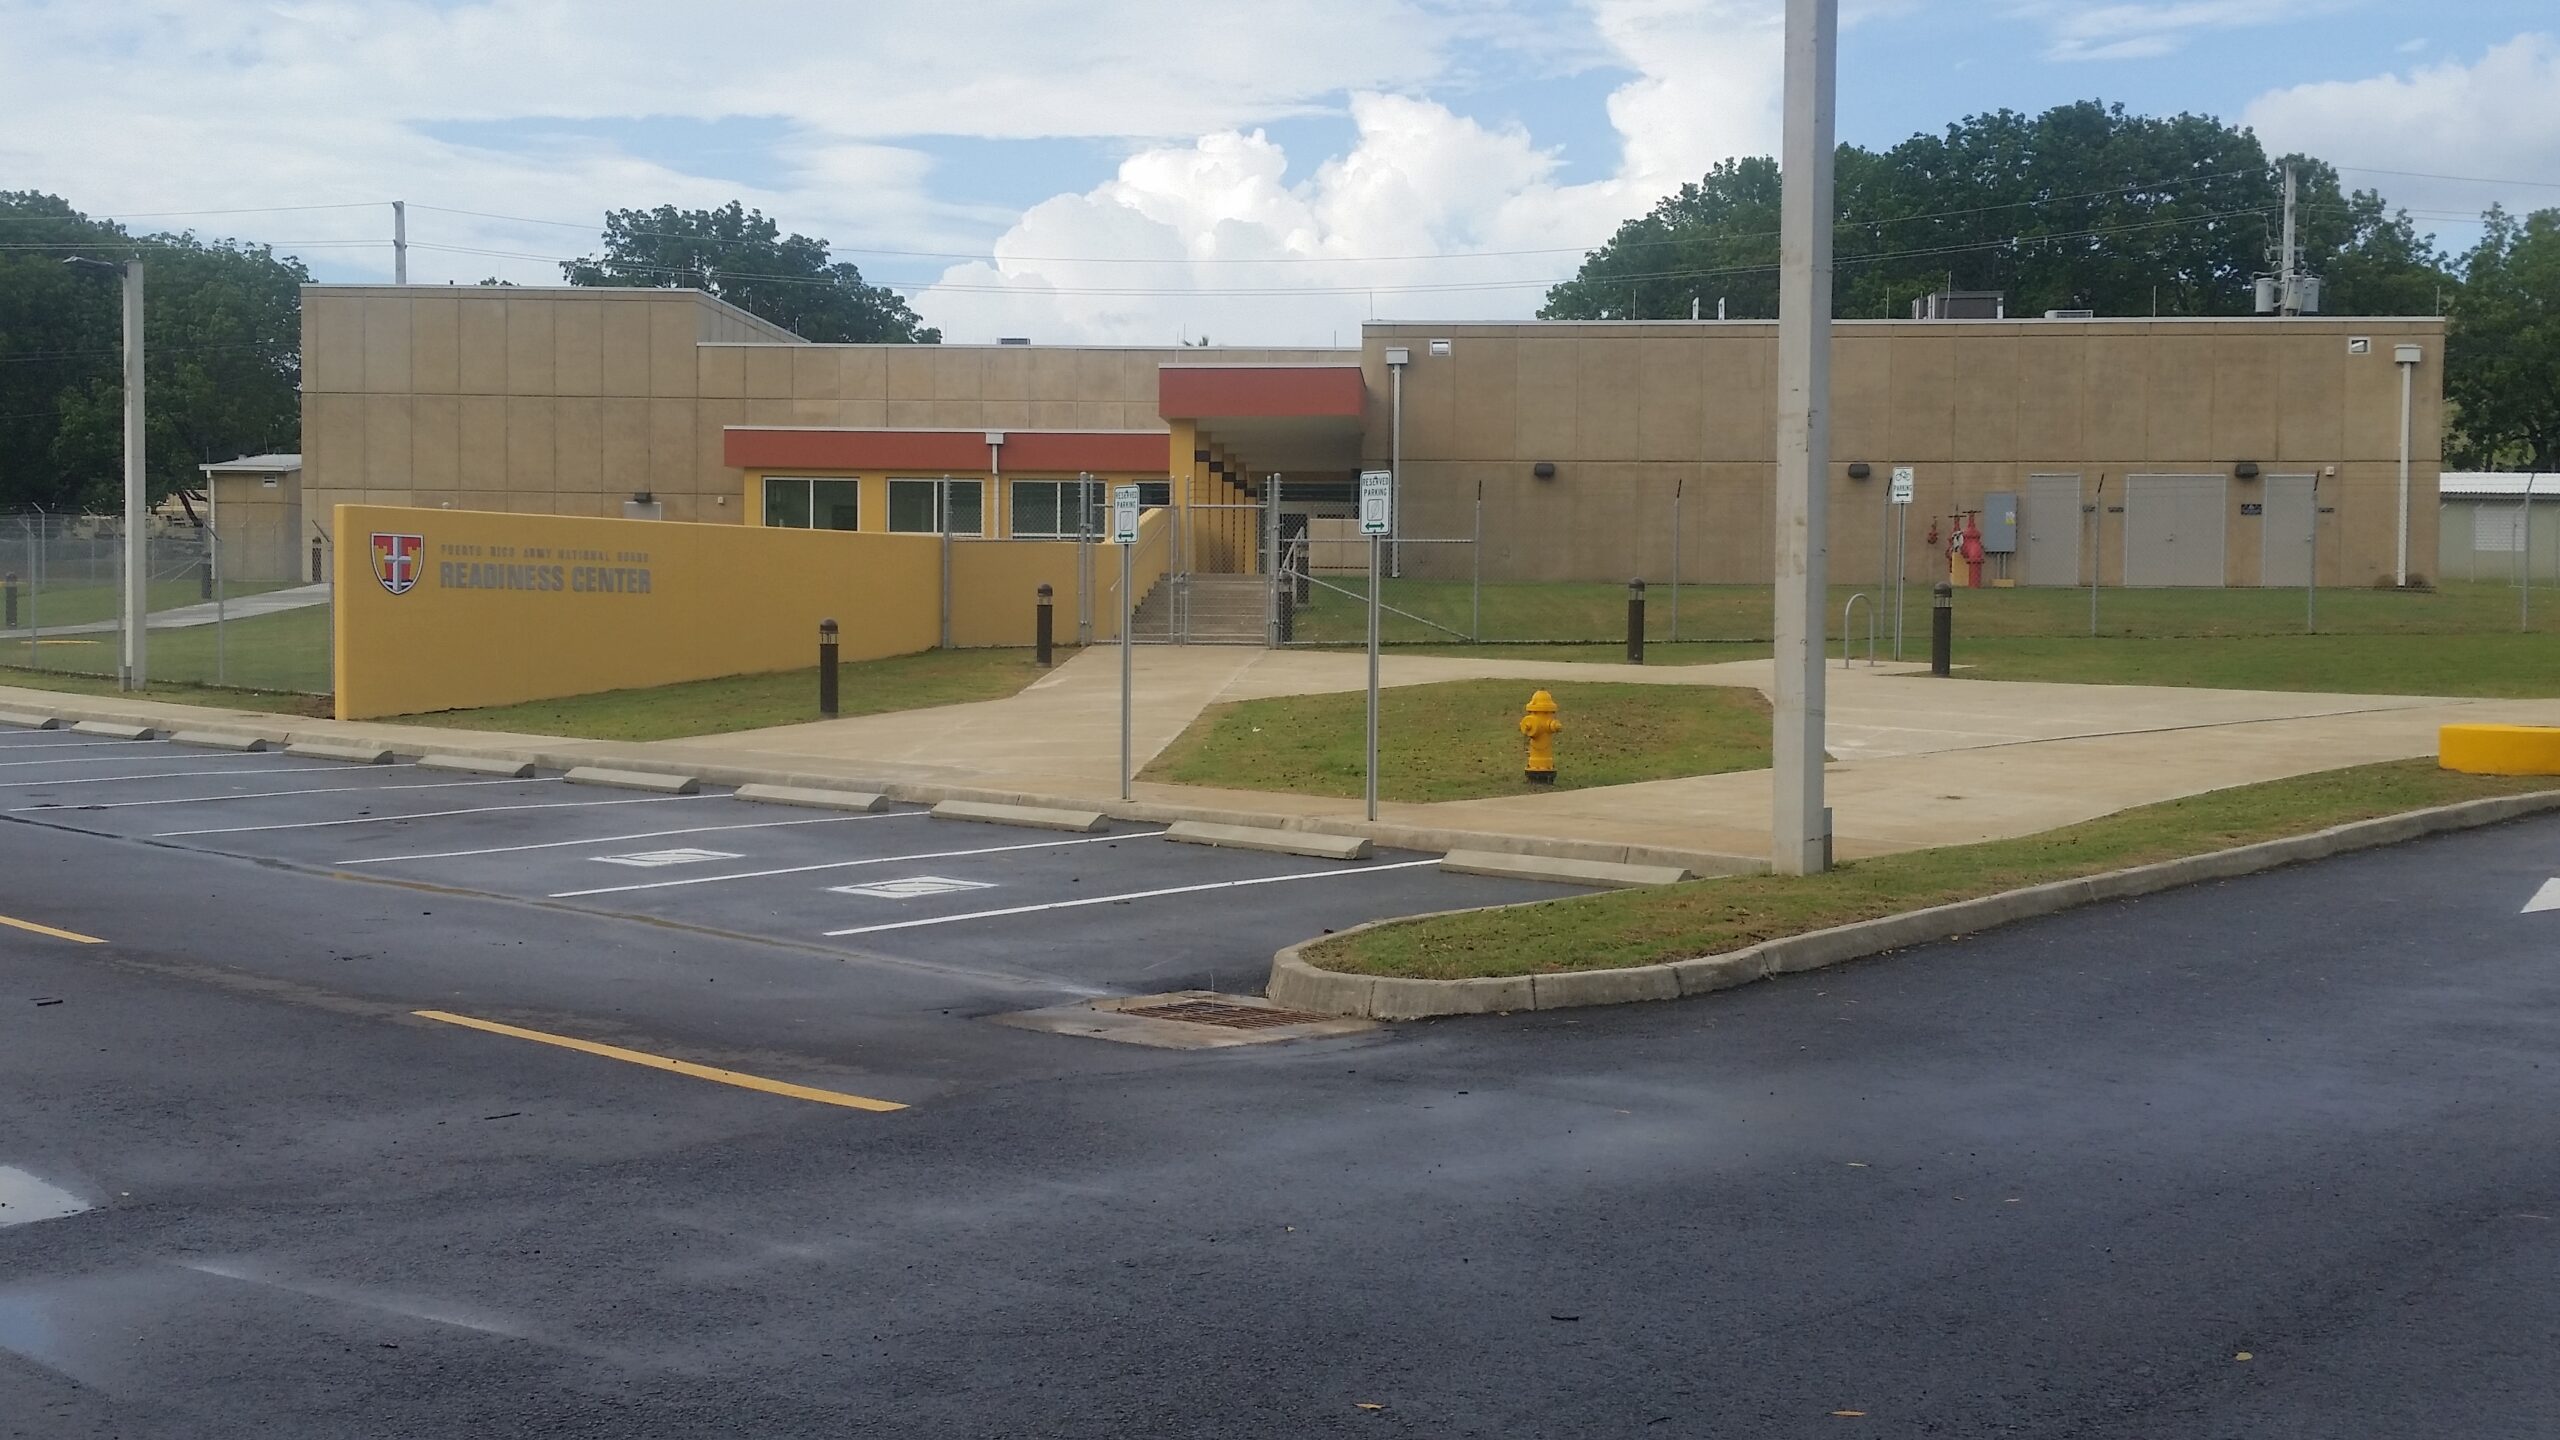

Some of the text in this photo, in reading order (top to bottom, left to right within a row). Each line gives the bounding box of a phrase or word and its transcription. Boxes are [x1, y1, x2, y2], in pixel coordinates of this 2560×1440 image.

[1363, 488, 1388, 496] PARKING
[441, 544, 482, 556] PUERTO
[440, 561, 652, 594] READINESS CENTER
